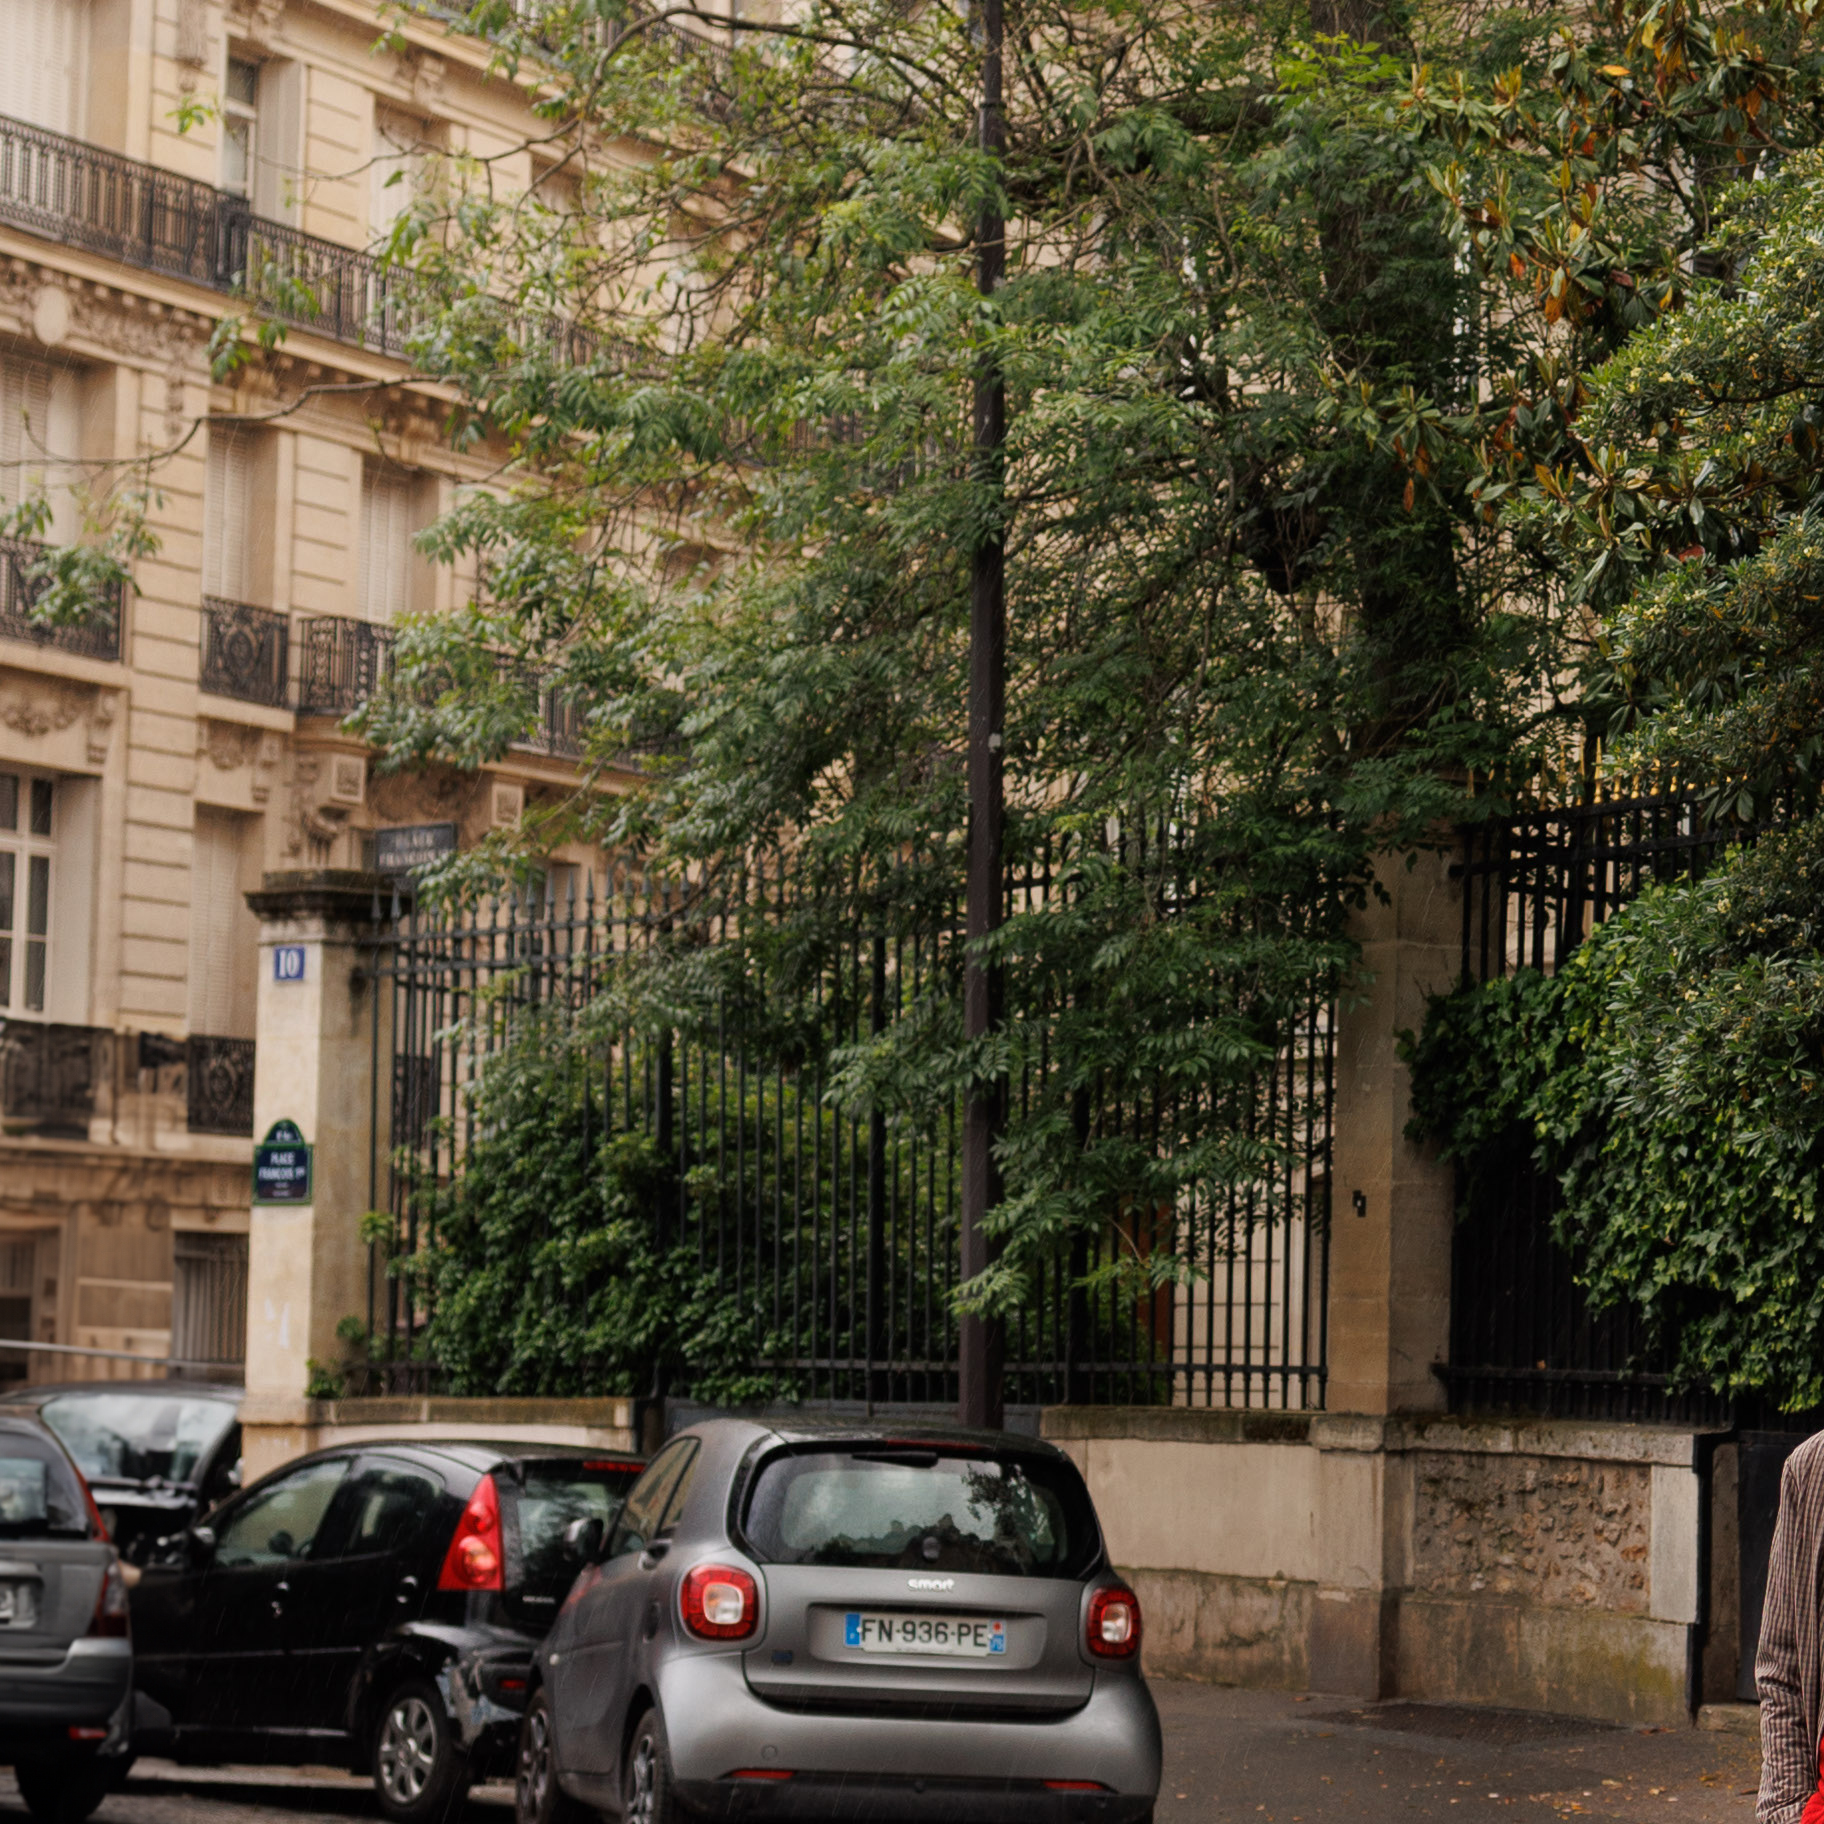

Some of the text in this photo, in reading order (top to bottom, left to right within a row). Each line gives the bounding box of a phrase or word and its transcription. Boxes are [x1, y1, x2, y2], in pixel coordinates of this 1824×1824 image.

[279, 950, 300, 977] 10
[908, 1578, 954, 1591] smart
[861, 1619, 987, 1647] FN-936-PE
